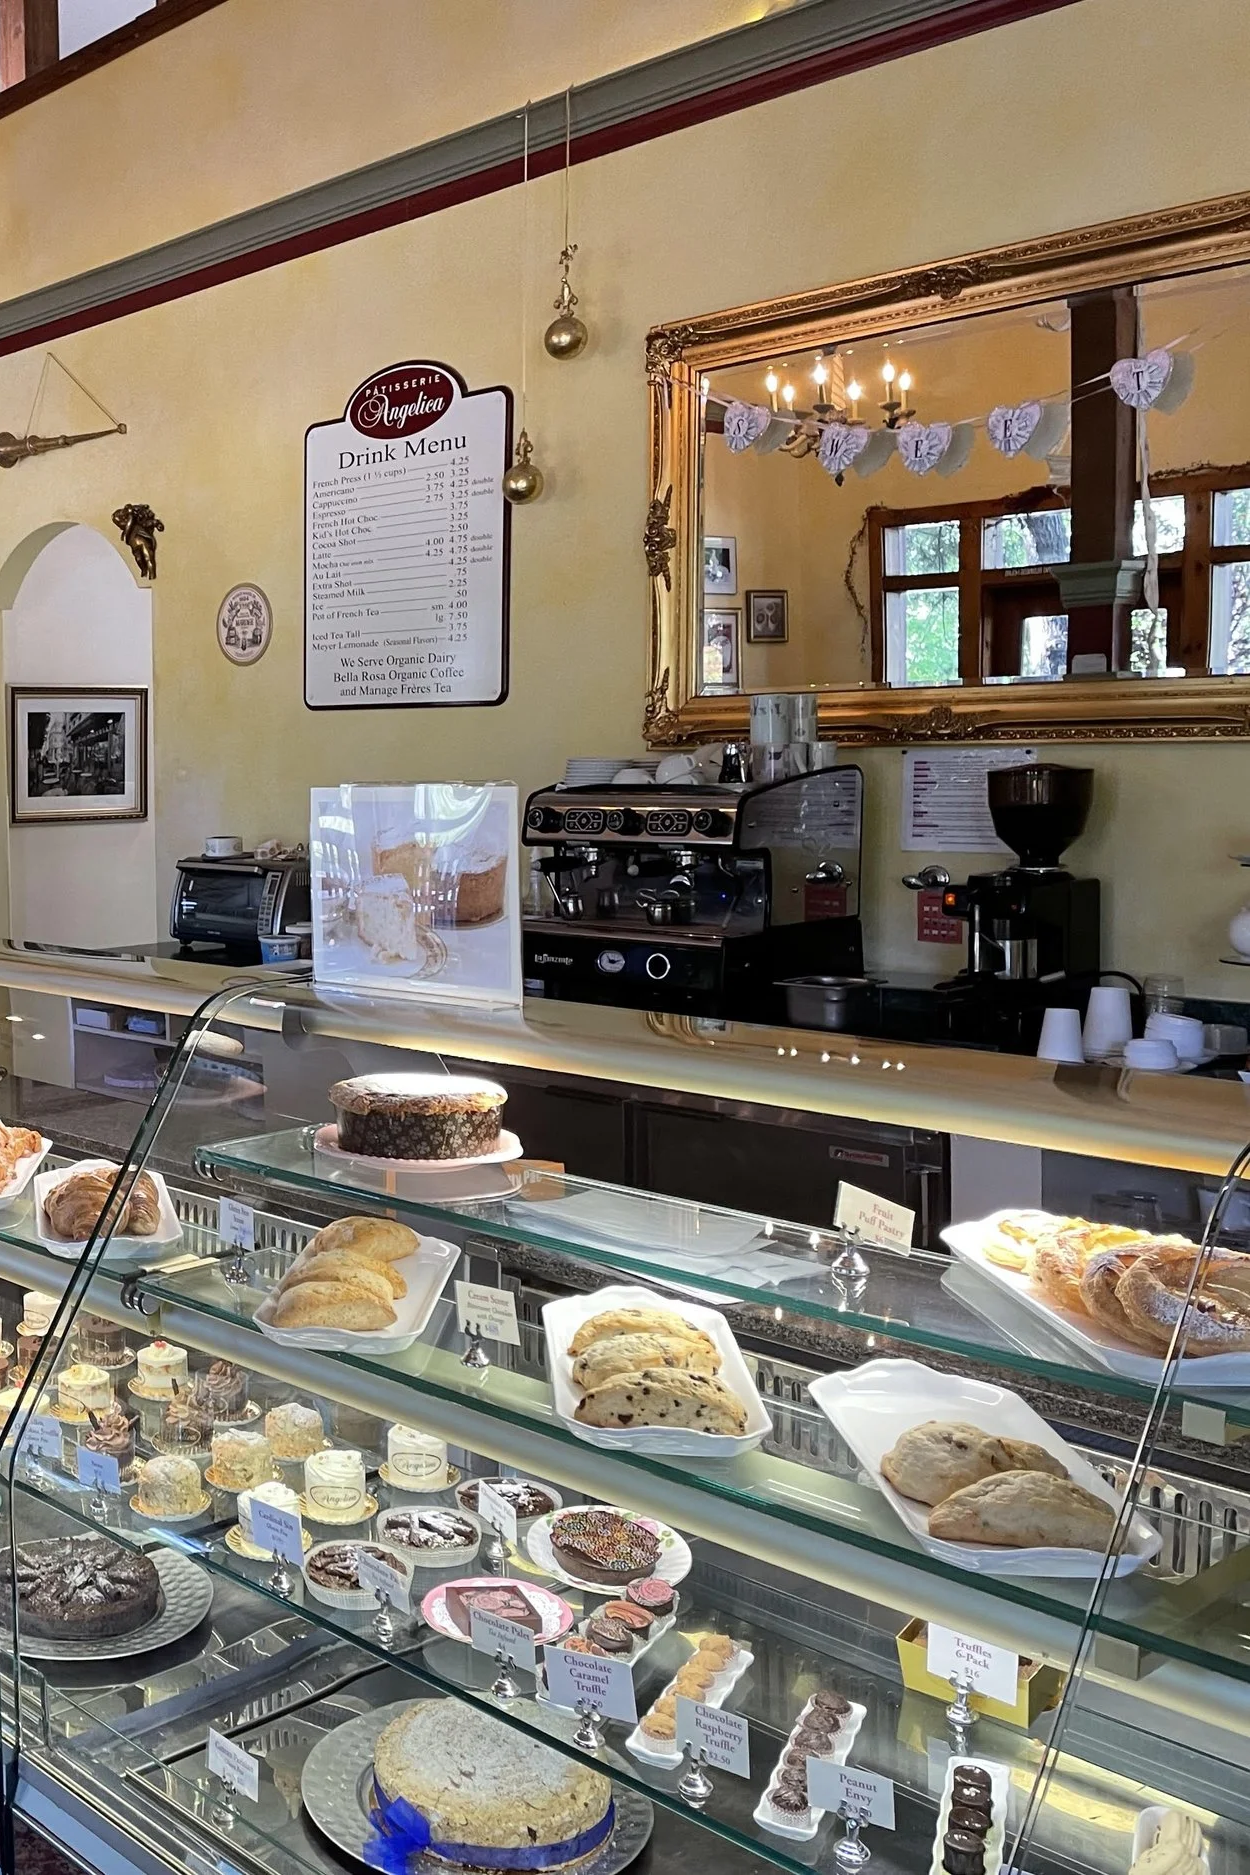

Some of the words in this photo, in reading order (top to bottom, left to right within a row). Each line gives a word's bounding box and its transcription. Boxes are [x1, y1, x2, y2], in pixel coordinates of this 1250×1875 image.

[1132, 370, 1144, 391] T
[358, 391, 445, 429] Angelica
[338, 443, 396, 469] Drink
[404, 435, 467, 459] Menu
[312, 478, 338, 489] French
[341, 475, 361, 484] Press
[383, 467, 406, 477] cups)
[312, 487, 355, 499] Americano
[425, 471, 444, 481] 2.50
[450, 467, 469, 478] 3.25
[312, 497, 357, 510] Cappuccino
[450, 478, 469, 488] 4.25
[312, 509, 346, 520] Espresso
[450, 490, 469, 500] 3.25
[312, 519, 338, 530] French
[341, 517, 355, 526] Hot
[450, 500, 468, 510] 3.75
[335, 528, 349, 537] Hot
[450, 512, 468, 521] 3.25
[312, 541, 336, 550] Cocoa
[339, 538, 356, 547] Shot
[449, 523, 468, 533] 2.50
[312, 552, 331, 560] Latte
[449, 534, 468, 543] 4.75
[312, 561, 338, 570] Mocha
[449, 545, 468, 554] 4.75
[312, 583, 332, 591] Extra
[334, 580, 352, 588] Shot
[326, 571, 341, 579] Lait
[312, 591, 345, 601] Steamed
[347, 588, 365, 597] Milk
[449, 578, 467, 588] 2.25
[312, 603, 324, 611] Ice
[312, 612, 325, 621] Pot
[326, 611, 335, 619] of
[337, 609, 363, 618] French
[366, 608, 379, 616] Tea
[449, 600, 468, 609] 4.00
[449, 611, 468, 620] 7.50
[312, 633, 328, 641] Iced
[330, 631, 343, 639] Tea
[346, 630, 360, 639] Tall
[312, 642, 336, 652] Meyer
[338, 640, 379, 649] Lemonade
[383, 637, 412, 647] (Seasonal
[448, 633, 468, 642] 4.25
[340, 657, 355, 668] We
[357, 656, 384, 668] Serve
[386, 654, 425, 668] Organic
[428, 652, 456, 665] Dairy
[333, 671, 359, 683] Bella
[361, 671, 386, 681] Rosa
[388, 669, 427, 682] Organic
[430, 667, 465, 679] Coffee
[340, 686, 357, 697] and
[401, 683, 431, 695] Frères
[434, 682, 452, 693] Tea
[873, 1203, 893, 1221] Fruit
[859, 1210, 876, 1226] Puff
[878, 1219, 904, 1240] Pastry
[473, 1611, 509, 1634] Chocolate
[954, 1637, 992, 1659] Truffles
[564, 1654, 612, 1674] Chocolate
[955, 1649, 990, 1670] 6-Pack
[569, 1668, 609, 1685] Caramel
[964, 1667, 980, 1678] $16
[574, 1680, 607, 1696] Truffle
[694, 1705, 743, 1731] Chocolate
[695, 1717, 743, 1745] Raspberry
[703, 1733, 735, 1754] Truffle
[708, 1751, 731, 1766] $2.50
[839, 1773, 878, 1793] Peanut
[845, 1788, 874, 1806] Envy
